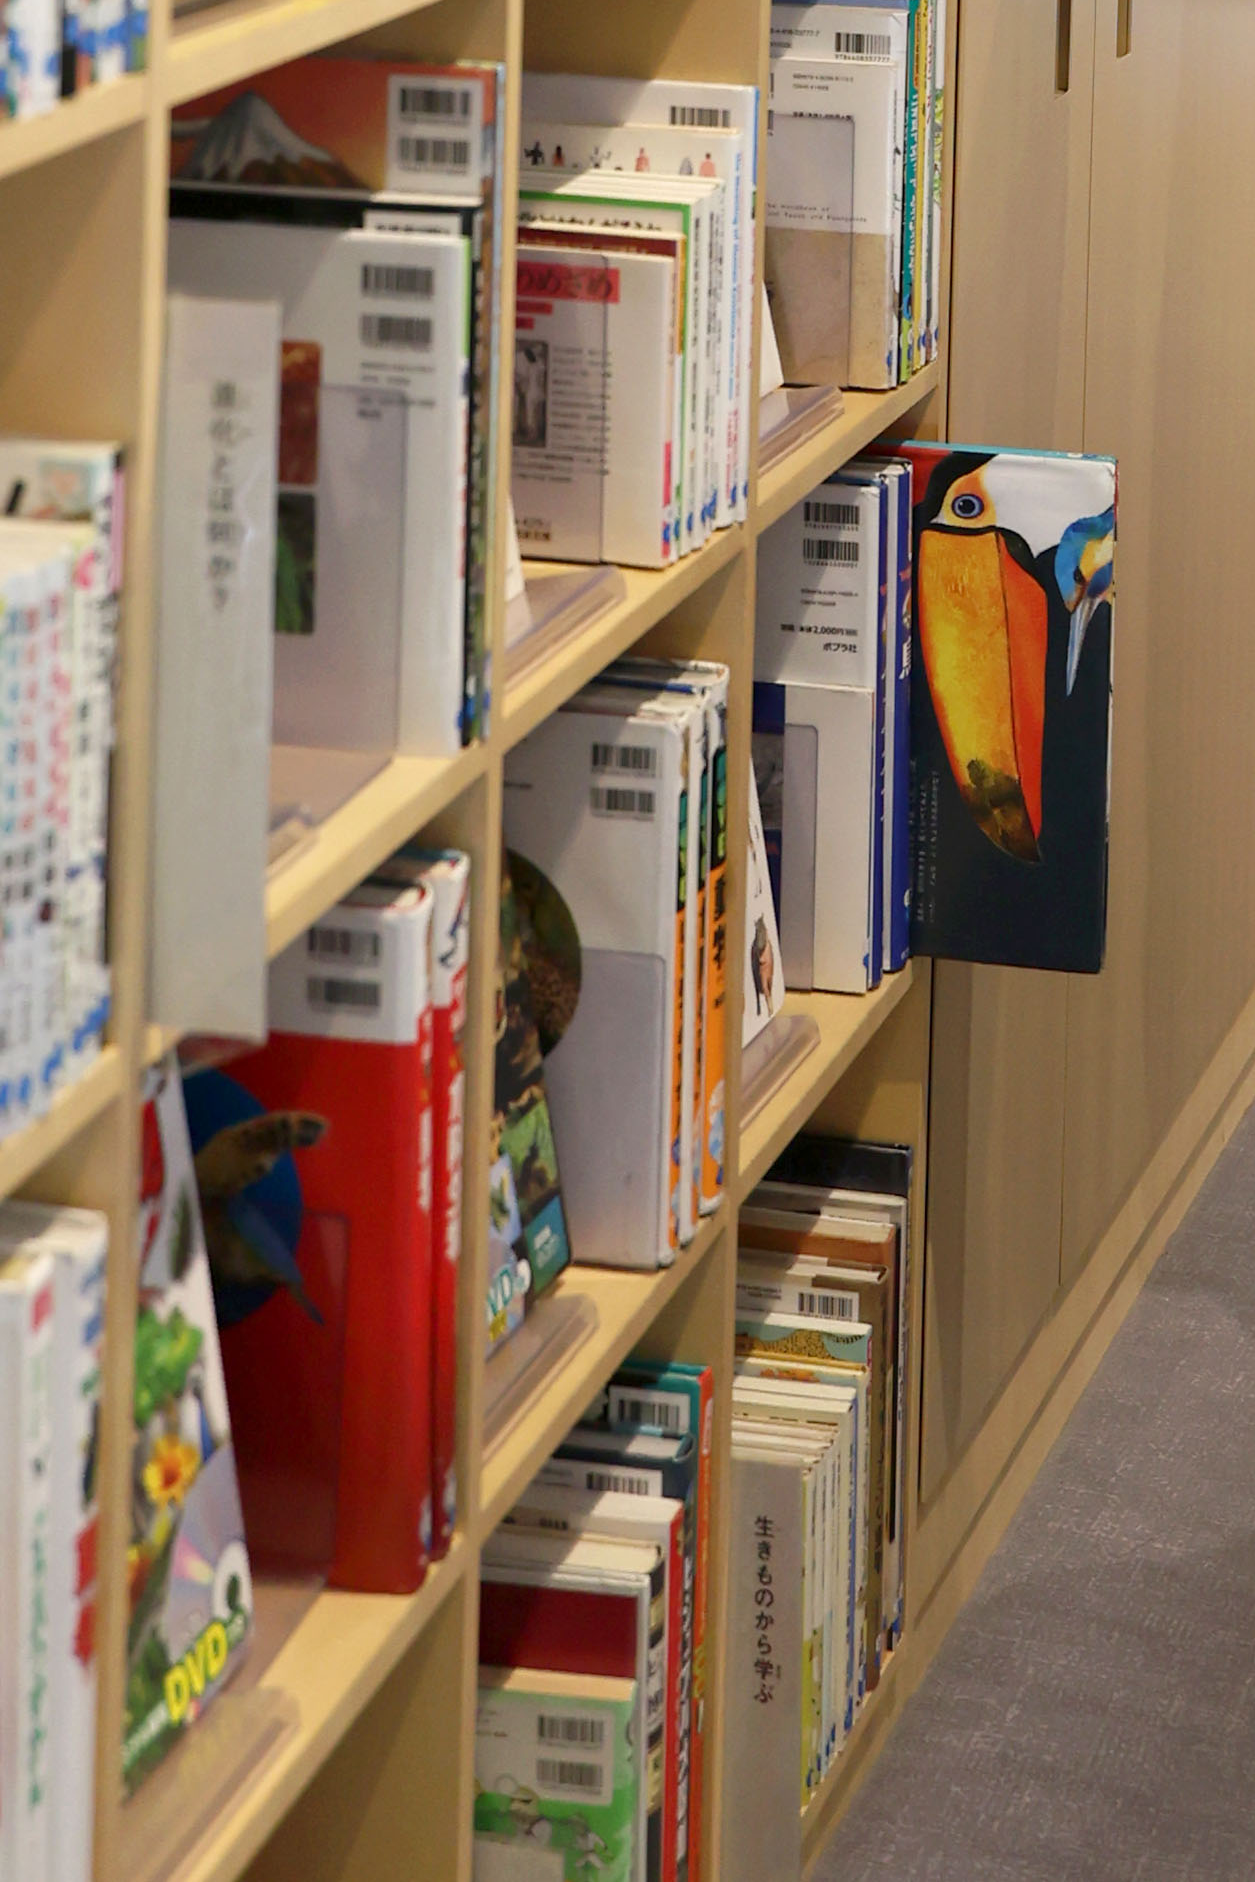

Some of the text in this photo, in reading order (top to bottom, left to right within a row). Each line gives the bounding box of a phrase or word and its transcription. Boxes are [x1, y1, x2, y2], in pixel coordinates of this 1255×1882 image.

[823, 641, 858, 654] ポプラ社
[754, 1514, 775, 1705] 生きものから学ぶ
[164, 1621, 228, 1726] DVD
